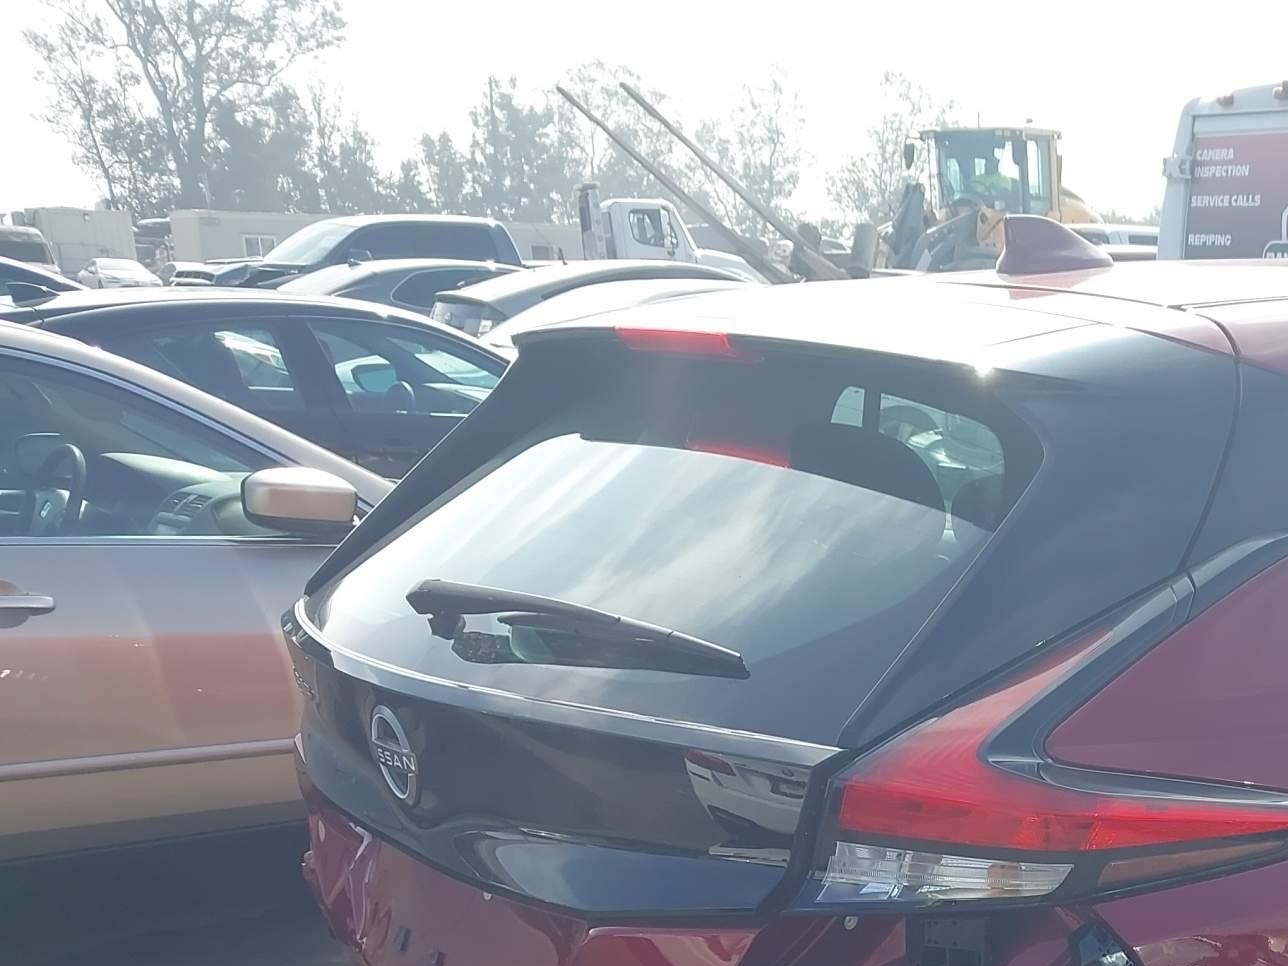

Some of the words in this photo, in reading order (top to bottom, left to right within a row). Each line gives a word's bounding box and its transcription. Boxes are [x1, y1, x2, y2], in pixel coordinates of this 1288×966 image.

[1196, 148, 1234, 161] CAMERA
[1194, 164, 1250, 177] INSPECTION
[1191, 195, 1230, 208] SERVICE
[1231, 194, 1261, 207] CALLS
[1188, 233, 1232, 247] REPIPING
[377, 747, 416, 771] SSAN
